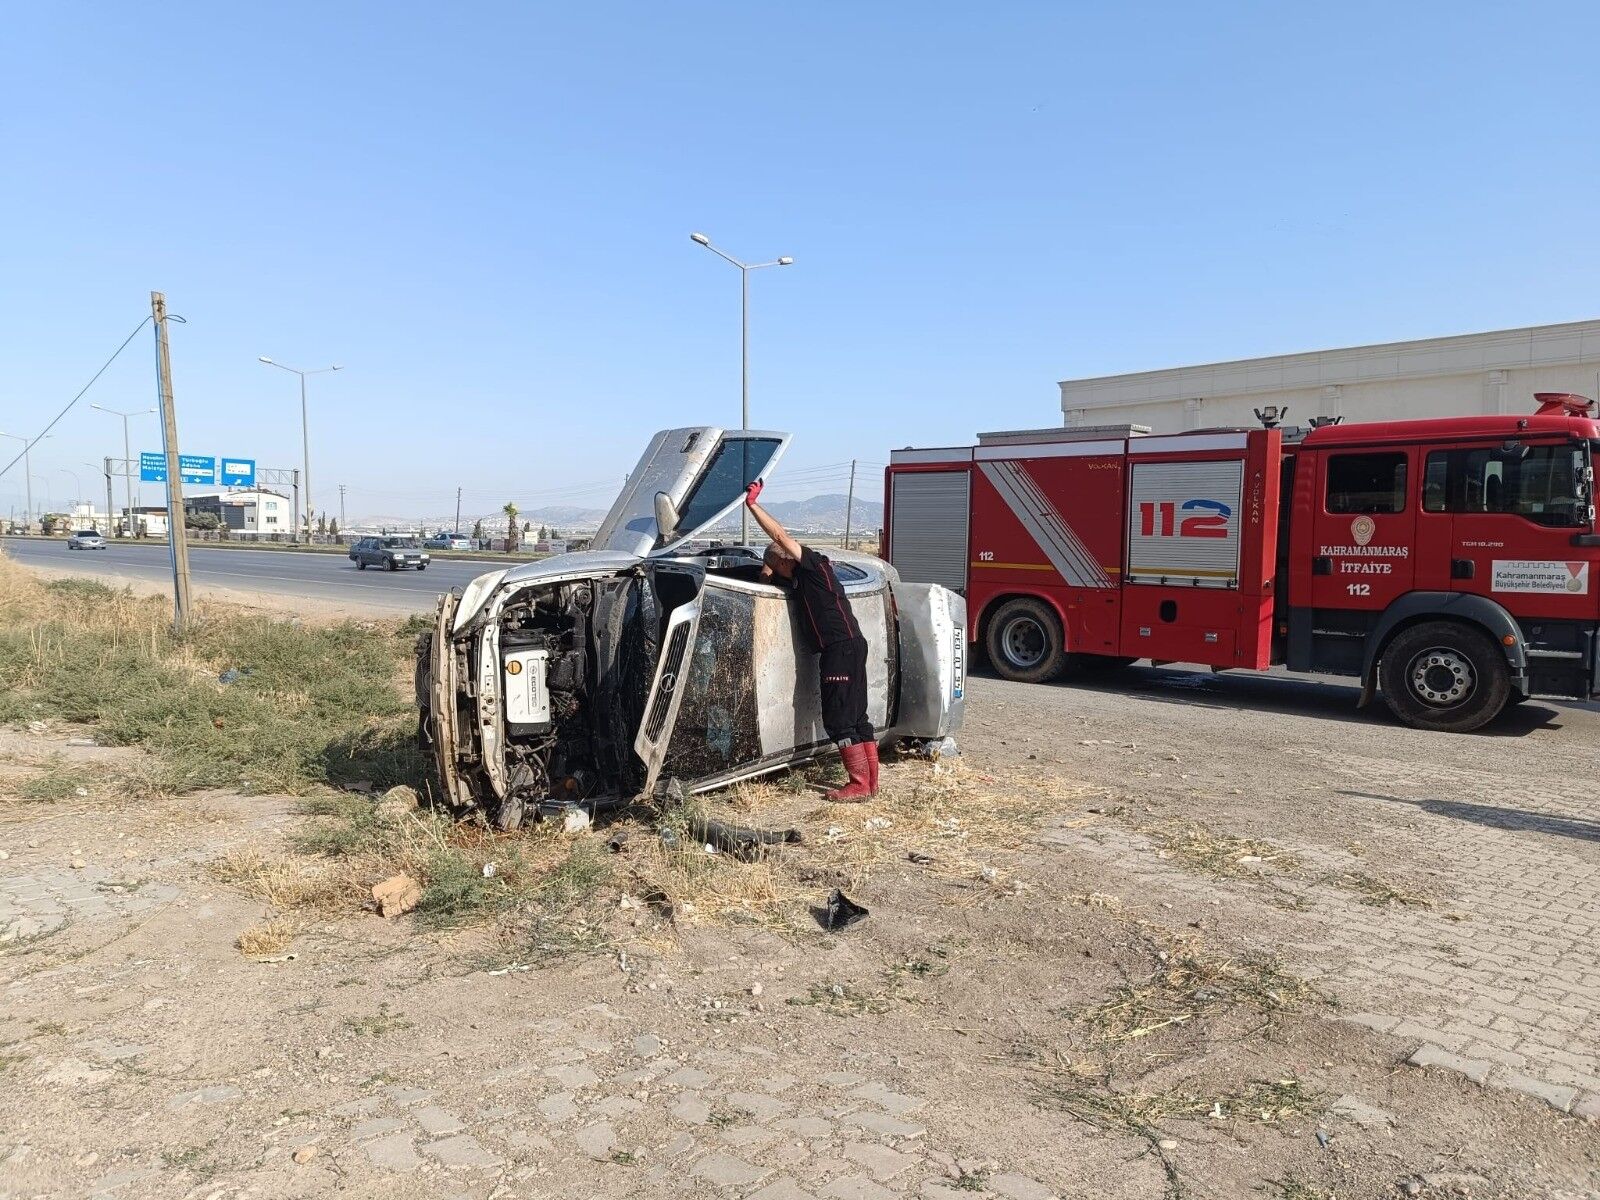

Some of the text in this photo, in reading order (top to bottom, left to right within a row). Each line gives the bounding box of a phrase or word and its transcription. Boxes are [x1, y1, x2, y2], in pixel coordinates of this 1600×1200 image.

[1140, 500, 1232, 538] 112
[978, 552, 994, 560] 112
[1320, 546, 1408, 559] KAHRAMANMARAŞ
[1340, 561, 1392, 574] İTFAİYE
[1496, 572, 1566, 581] Kahramanmaraş
[1346, 584, 1370, 596] 112
[1495, 580, 1566, 590] Büyükşehir Belediyesi
